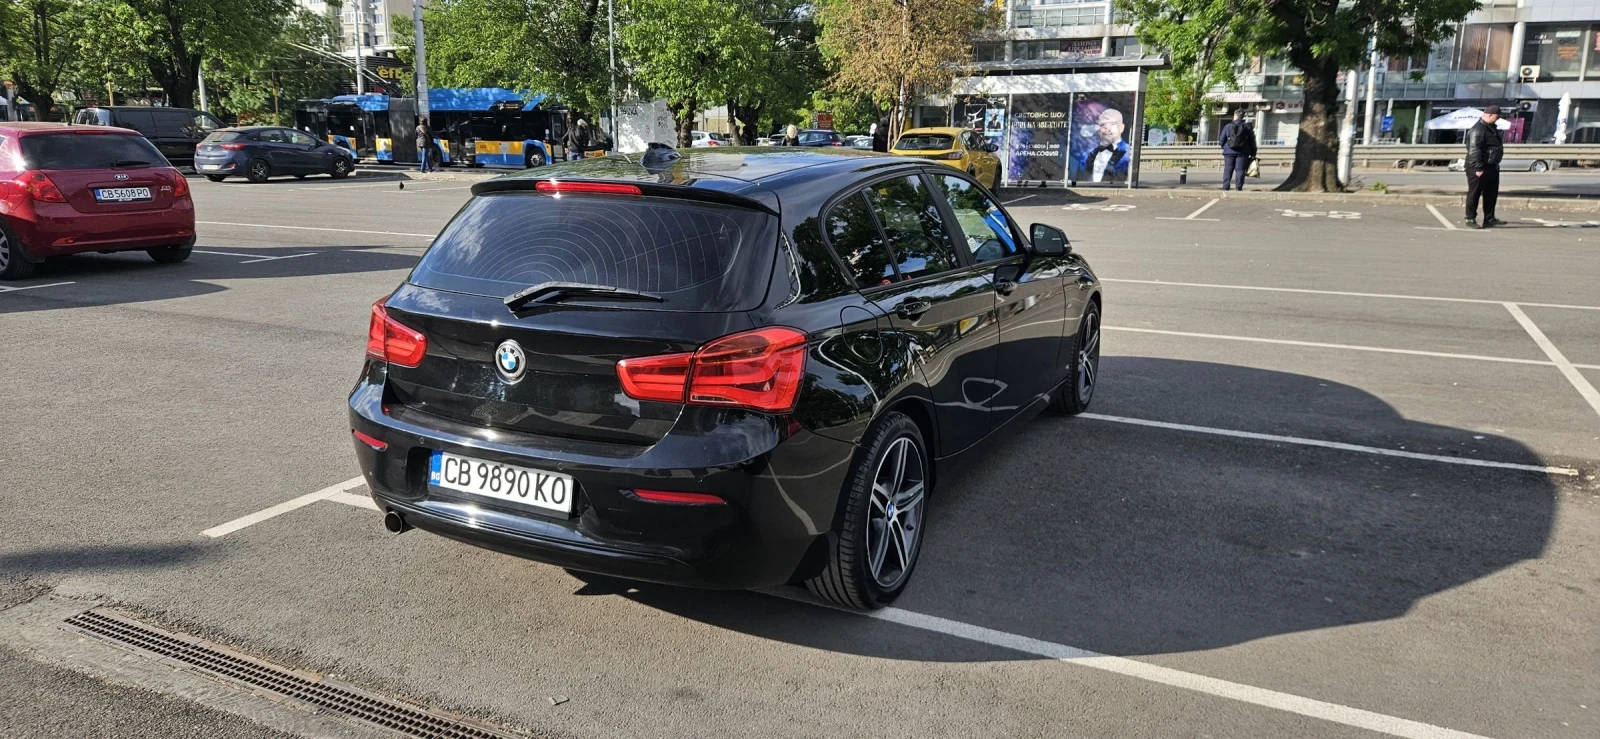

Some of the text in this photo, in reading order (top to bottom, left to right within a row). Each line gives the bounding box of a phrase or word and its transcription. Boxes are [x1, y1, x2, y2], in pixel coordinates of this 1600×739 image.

[377, 67, 414, 79] efbe
[101, 188, 149, 198] CB 5608 PO
[430, 471, 441, 481] BG
[444, 457, 566, 505] CB 9890 KO
